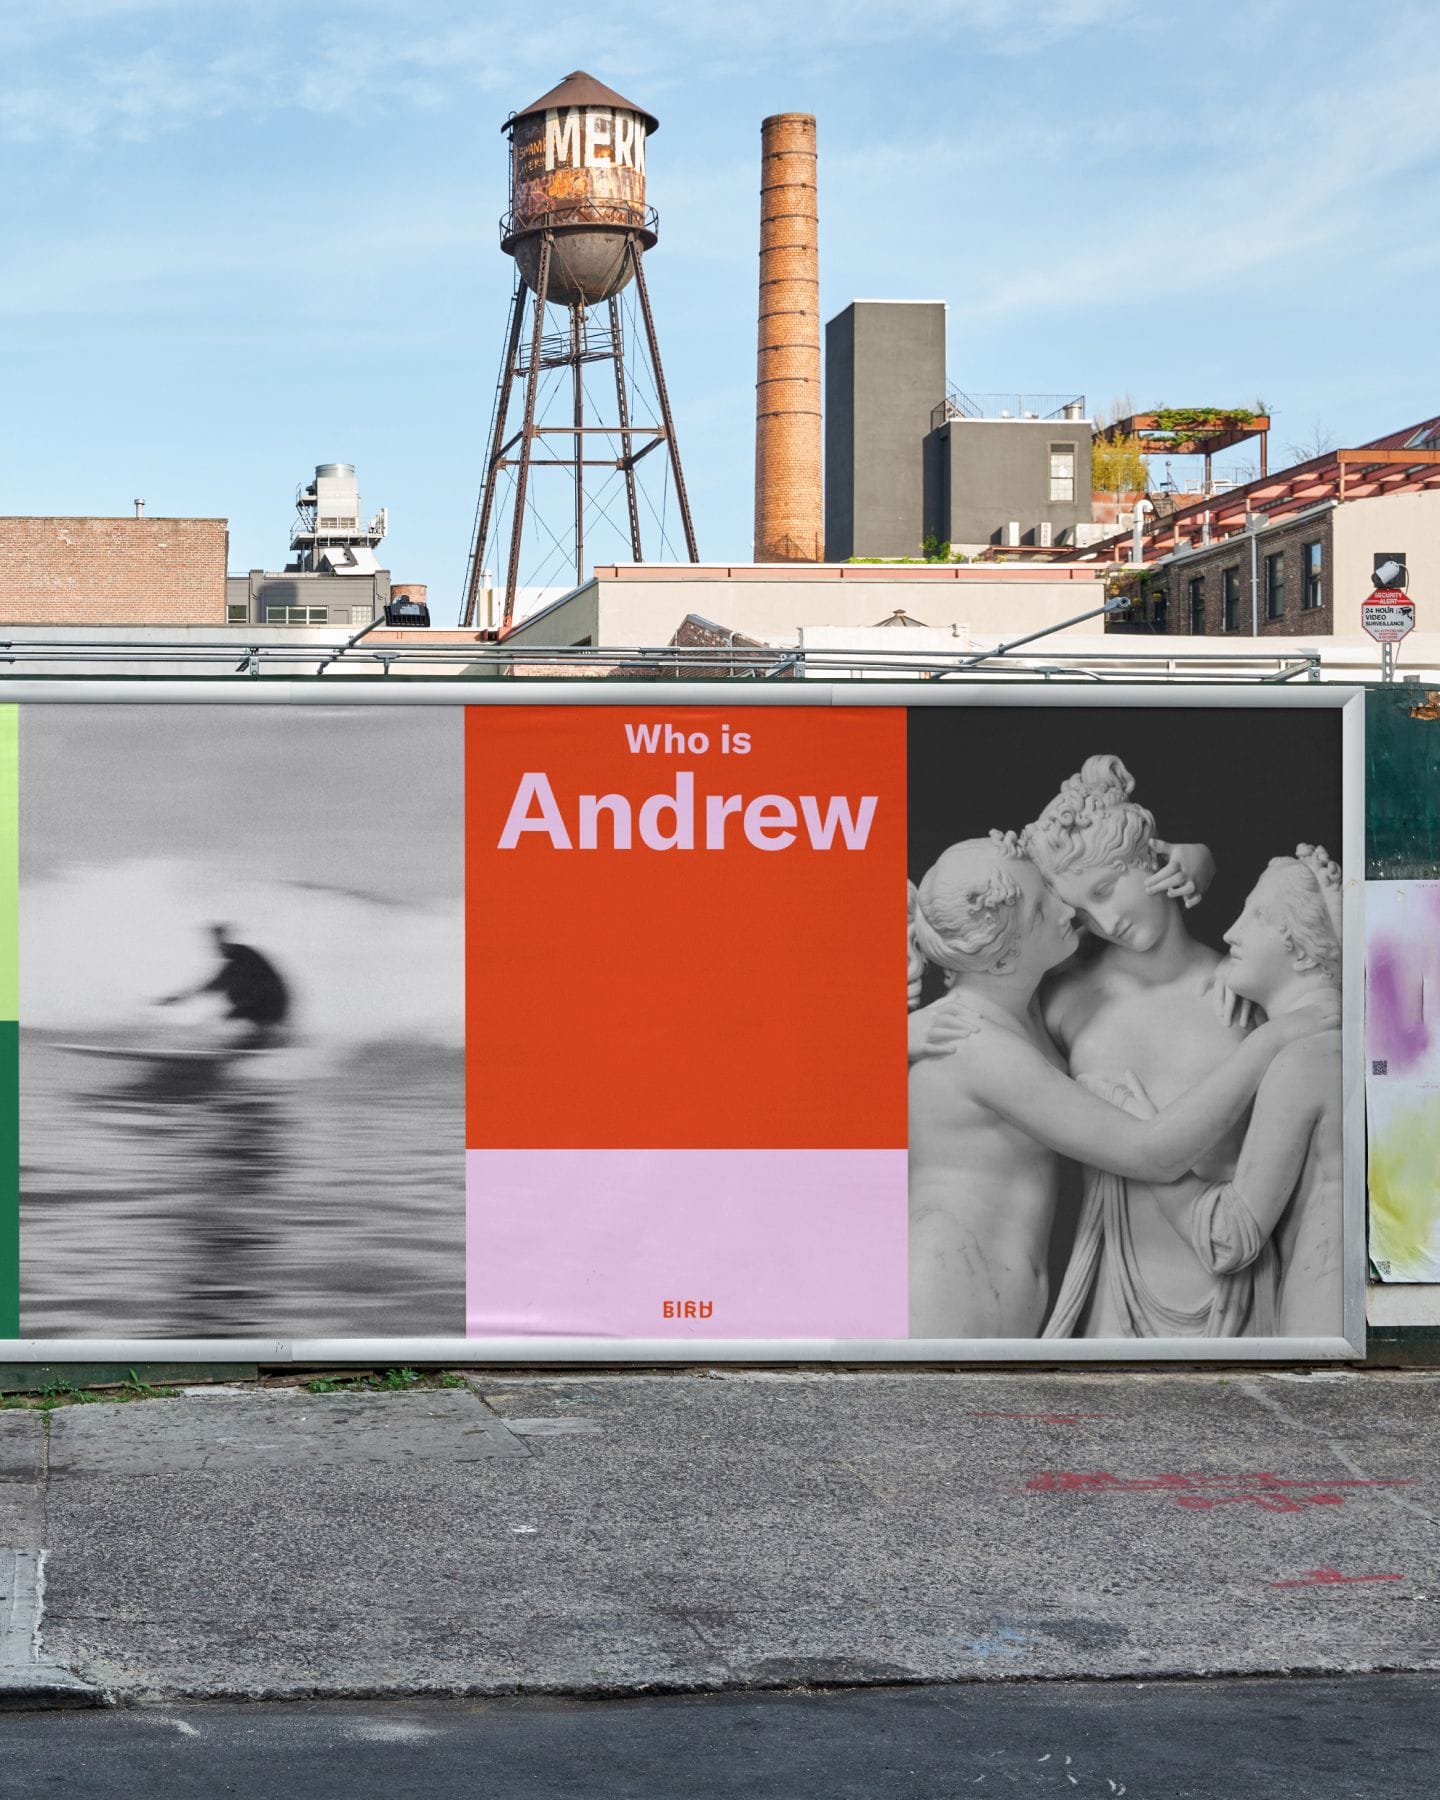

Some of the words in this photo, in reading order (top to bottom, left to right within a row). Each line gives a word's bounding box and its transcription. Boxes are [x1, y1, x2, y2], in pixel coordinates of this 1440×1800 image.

[625, 724, 709, 754] Who
[722, 724, 751, 754] is
[497, 772, 878, 851] Andrew
